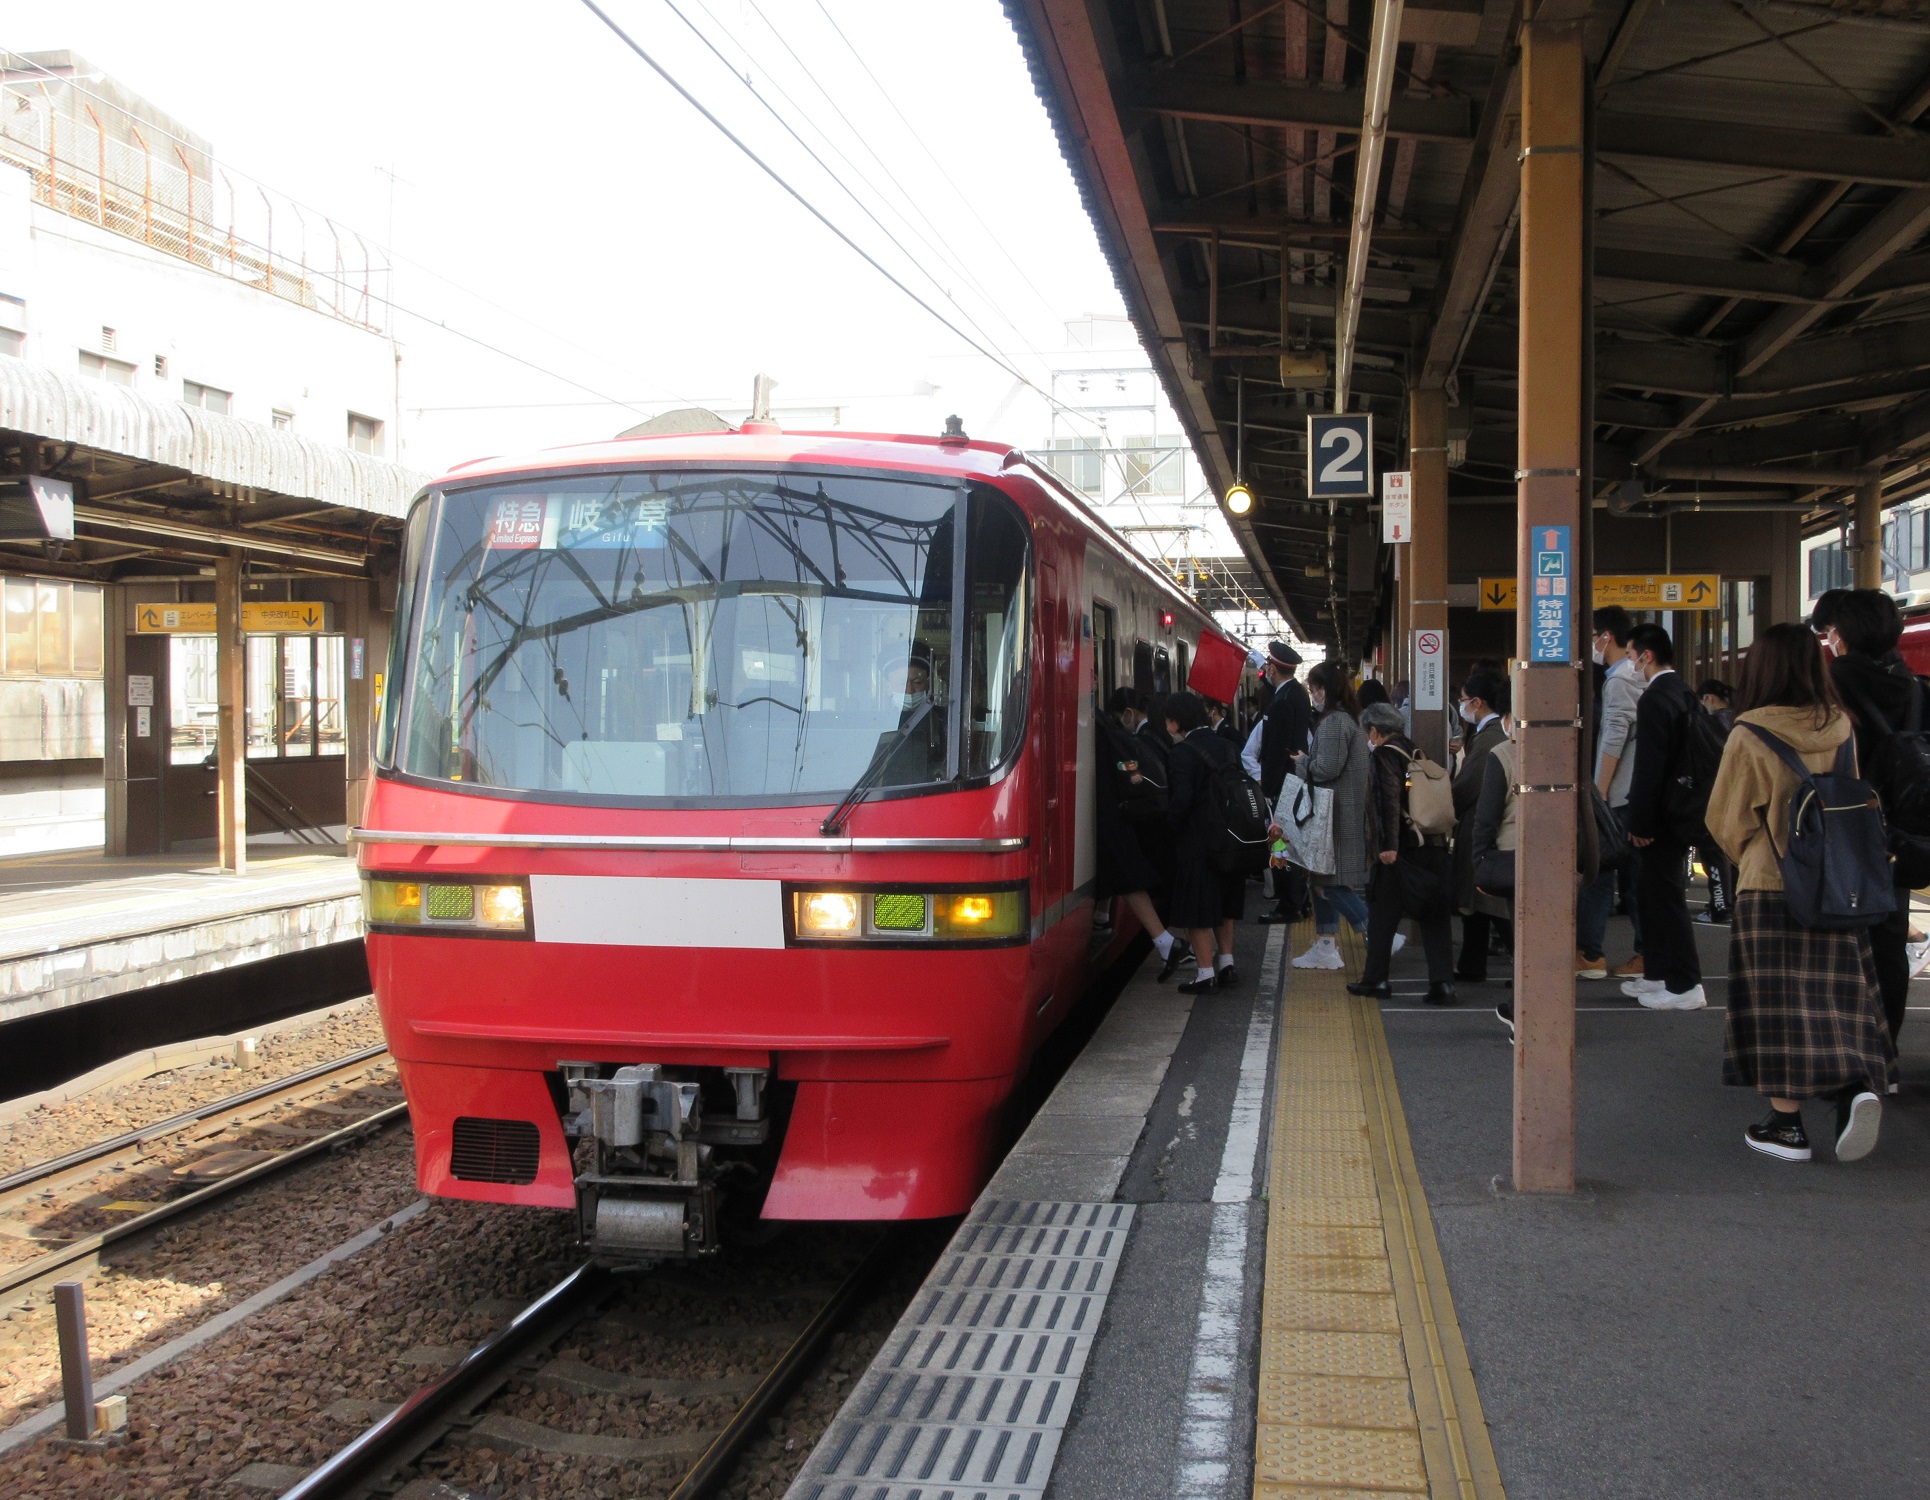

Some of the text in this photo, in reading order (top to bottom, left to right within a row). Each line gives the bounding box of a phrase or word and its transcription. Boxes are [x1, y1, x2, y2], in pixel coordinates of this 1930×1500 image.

[1320, 427, 1363, 483] 2
[494, 500, 541, 532] 特急
[568, 499, 667, 533] 岐阜
[493, 533, 538, 543] Limited Express
[602, 532, 630, 542] Gifu
[1537, 599, 1564, 658] 特別車のりば
[1714, 884, 1726, 911] YONEX
